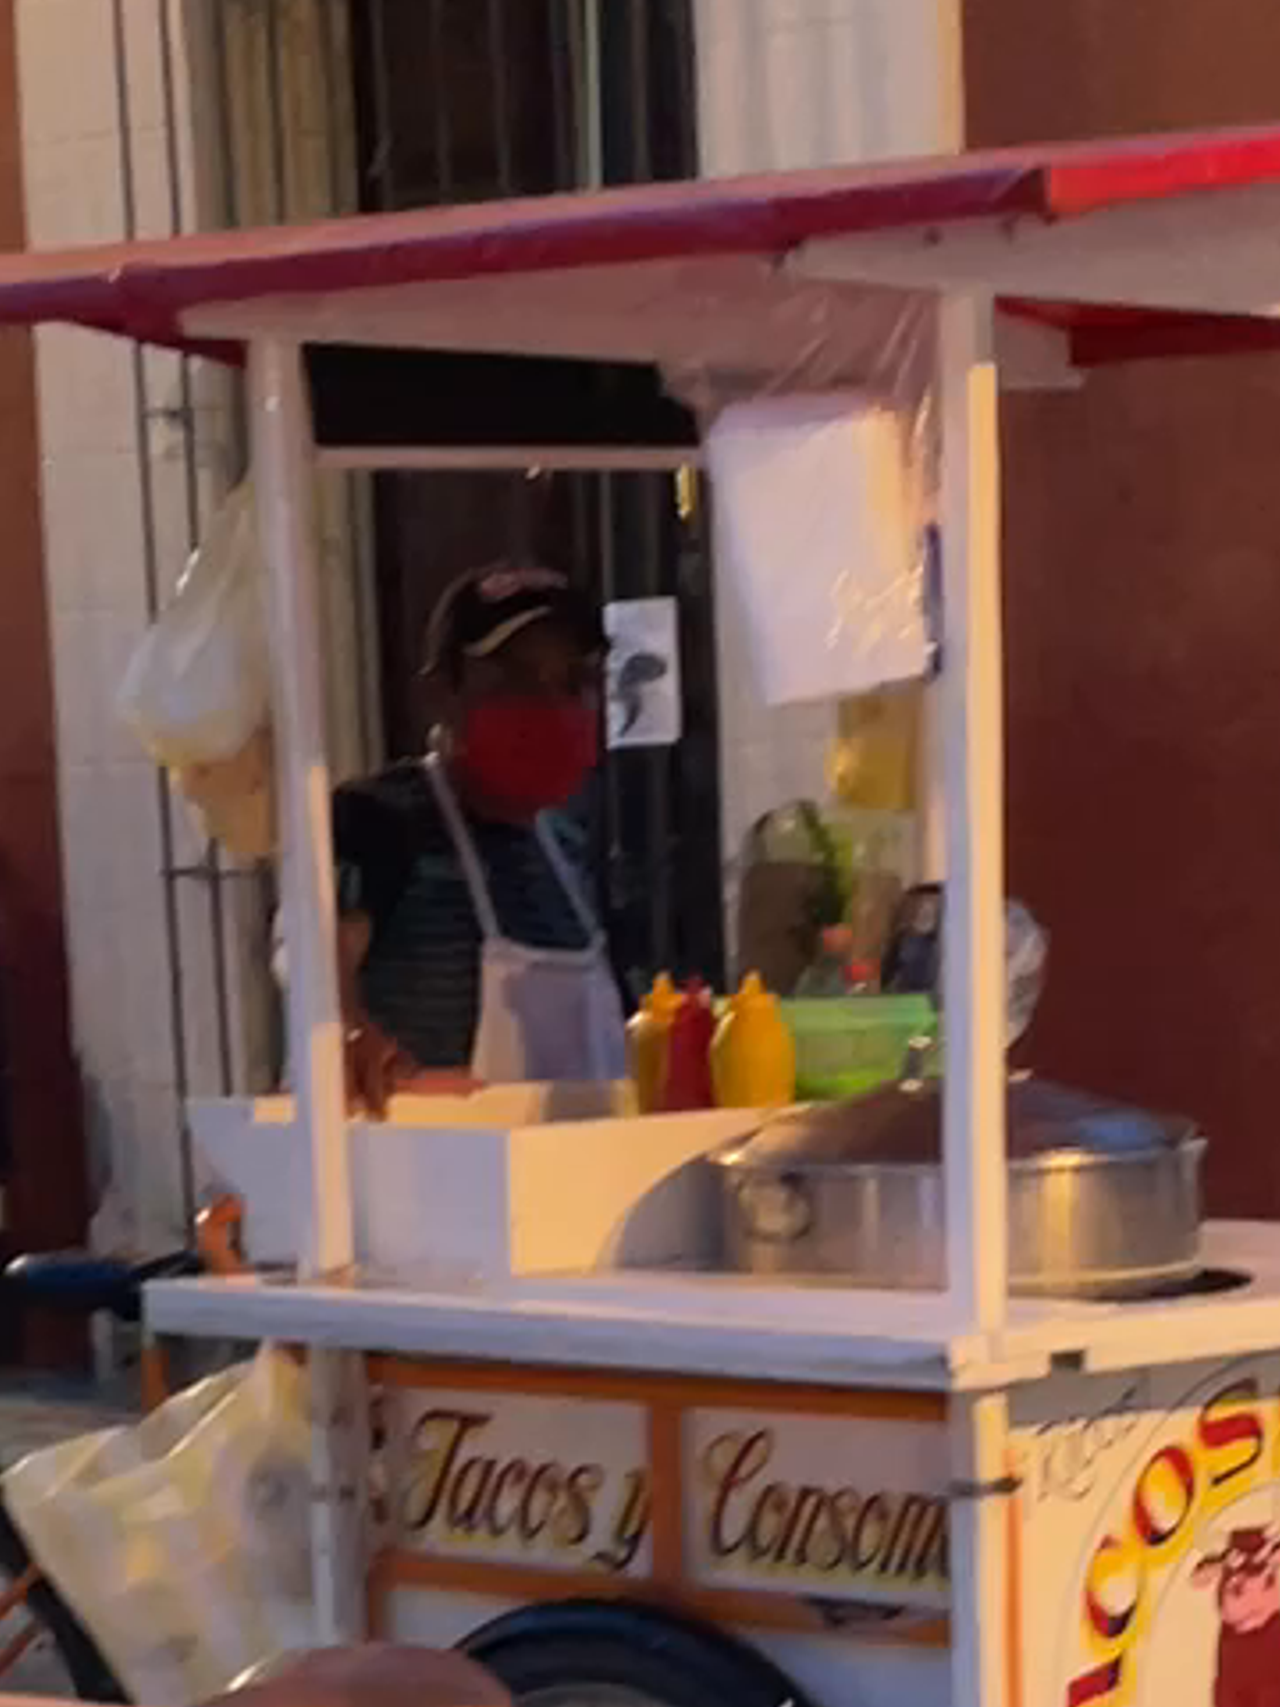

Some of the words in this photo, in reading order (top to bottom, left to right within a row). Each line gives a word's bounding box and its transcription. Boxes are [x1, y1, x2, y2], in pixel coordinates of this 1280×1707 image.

[403, 1407, 604, 1547] Tacos
[592, 1465, 652, 1572] y
[702, 1426, 952, 1581] Consom
